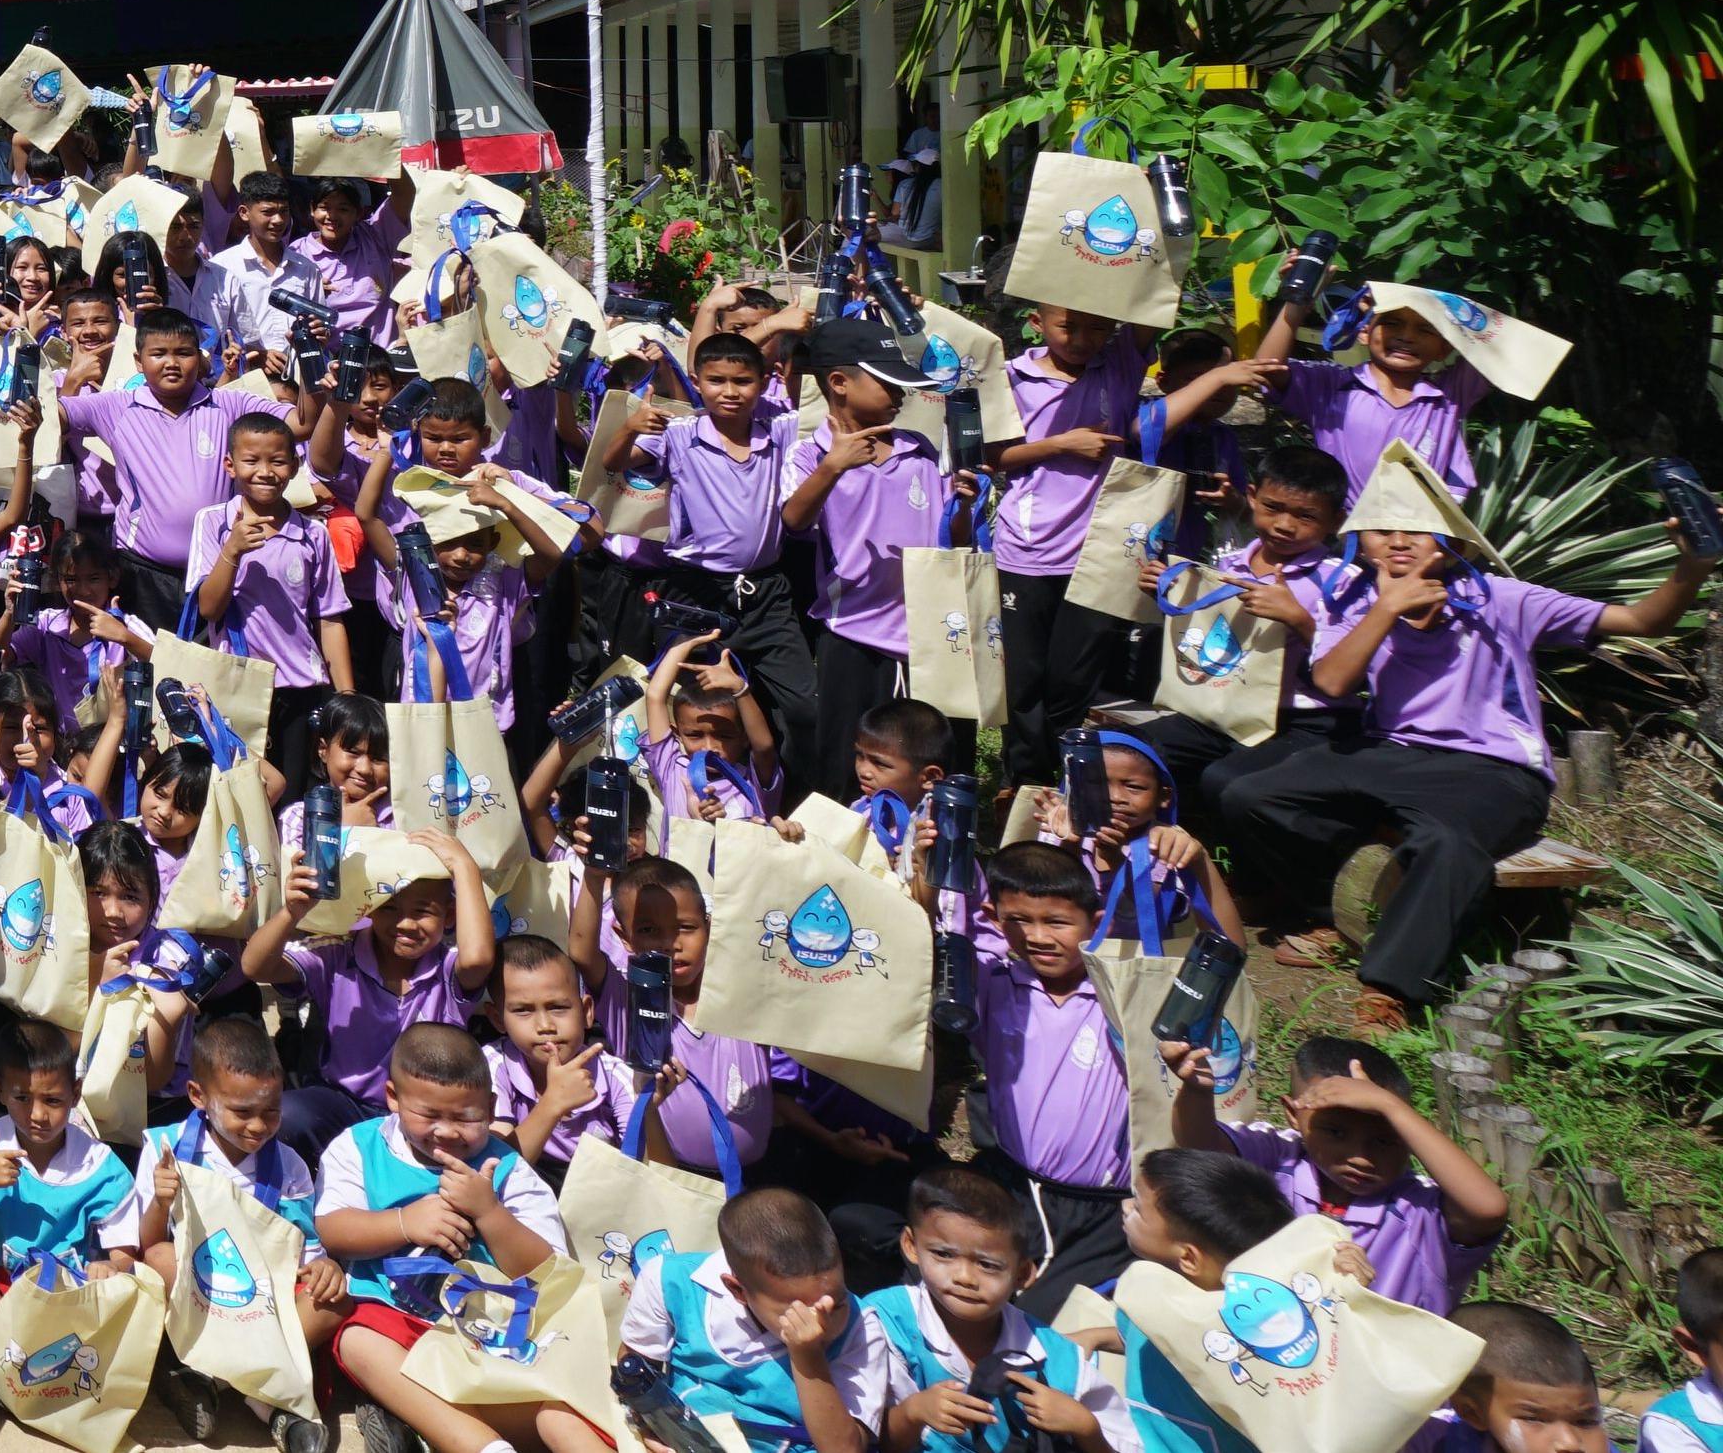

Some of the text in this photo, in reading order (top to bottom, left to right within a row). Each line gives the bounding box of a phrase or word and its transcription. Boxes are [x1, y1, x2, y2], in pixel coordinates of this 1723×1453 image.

[1091, 240, 1126, 253] ISUZU
[587, 806, 618, 819] ISUZU
[5, 925, 34, 946] ISUZU
[796, 949, 838, 963] ISUZU
[1280, 1331, 1318, 1366] ISUZU
